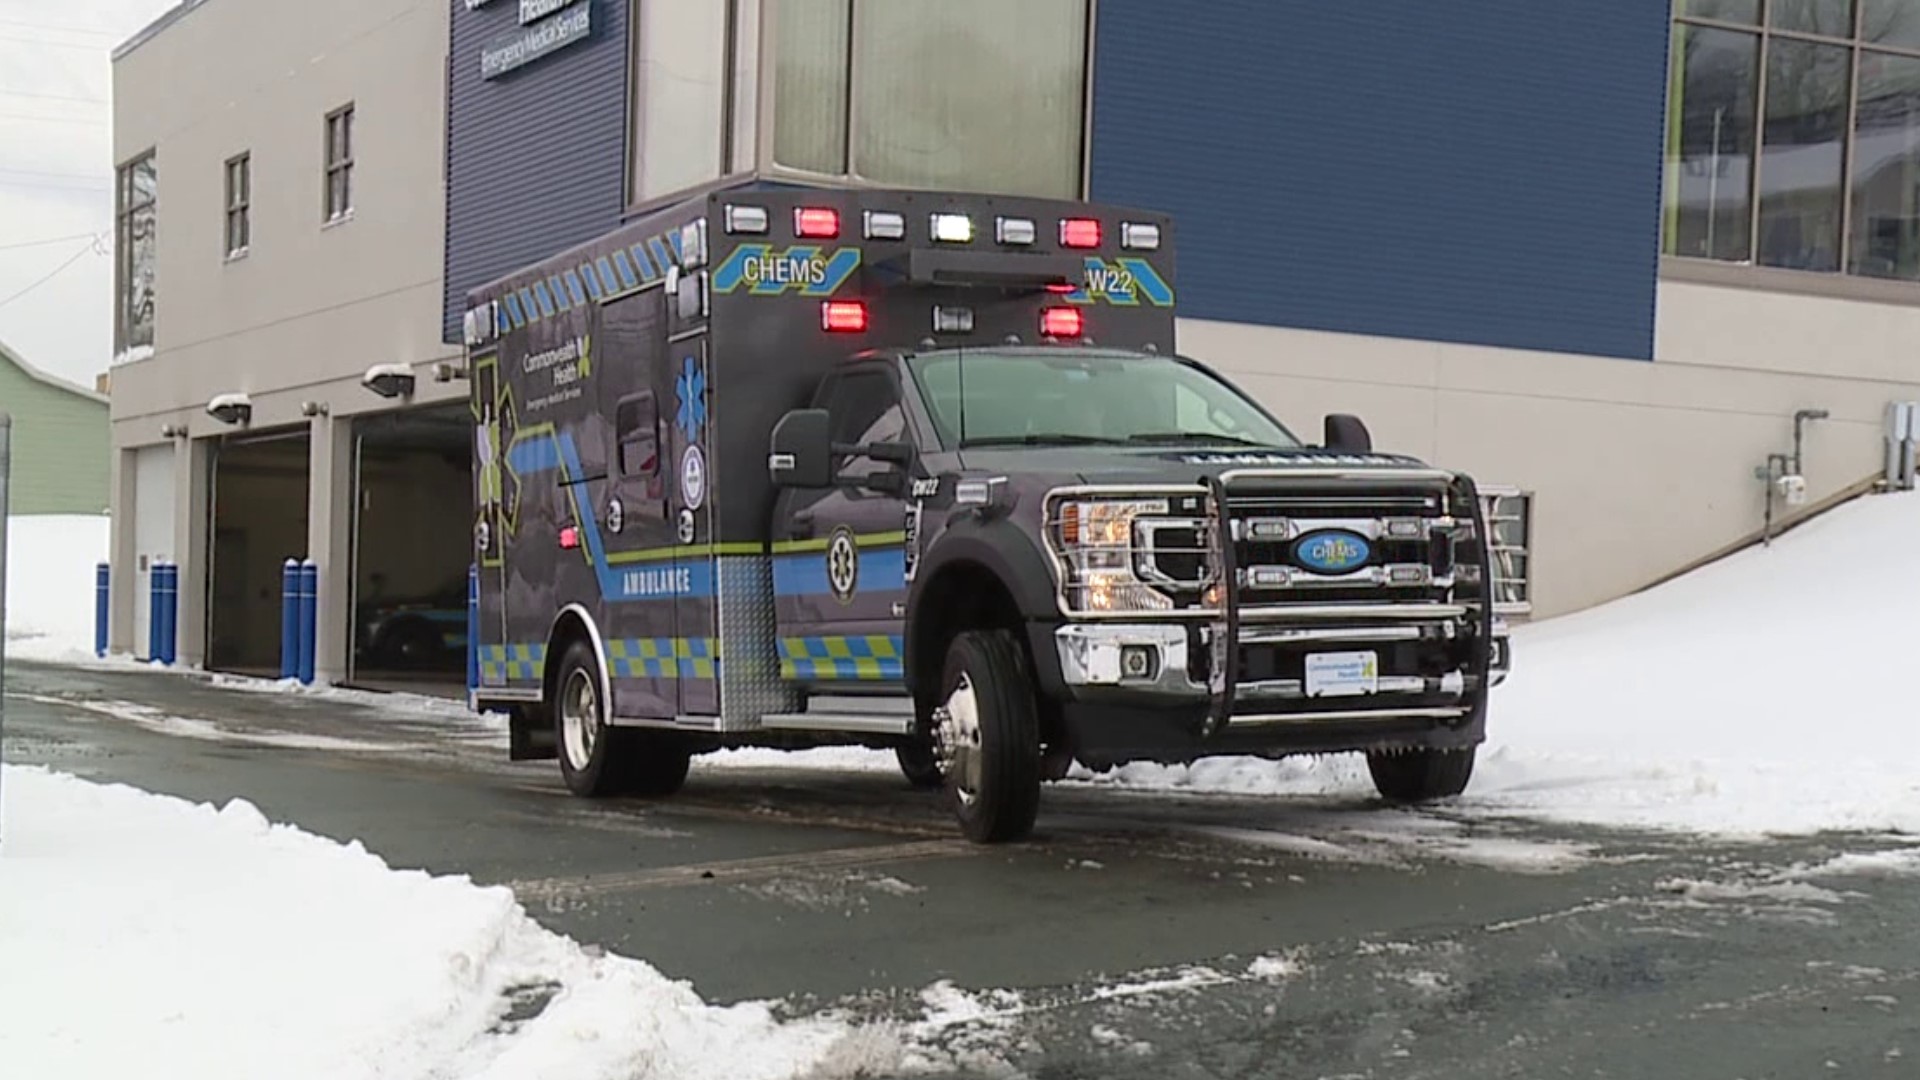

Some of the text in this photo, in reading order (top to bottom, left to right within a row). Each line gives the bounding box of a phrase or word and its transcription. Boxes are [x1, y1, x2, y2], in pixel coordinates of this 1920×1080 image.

[743, 255, 826, 284] CHEMS
[1083, 268, 1133, 294] W22
[553, 361, 576, 386] Health
[623, 567, 691, 596] AMBULANCE
